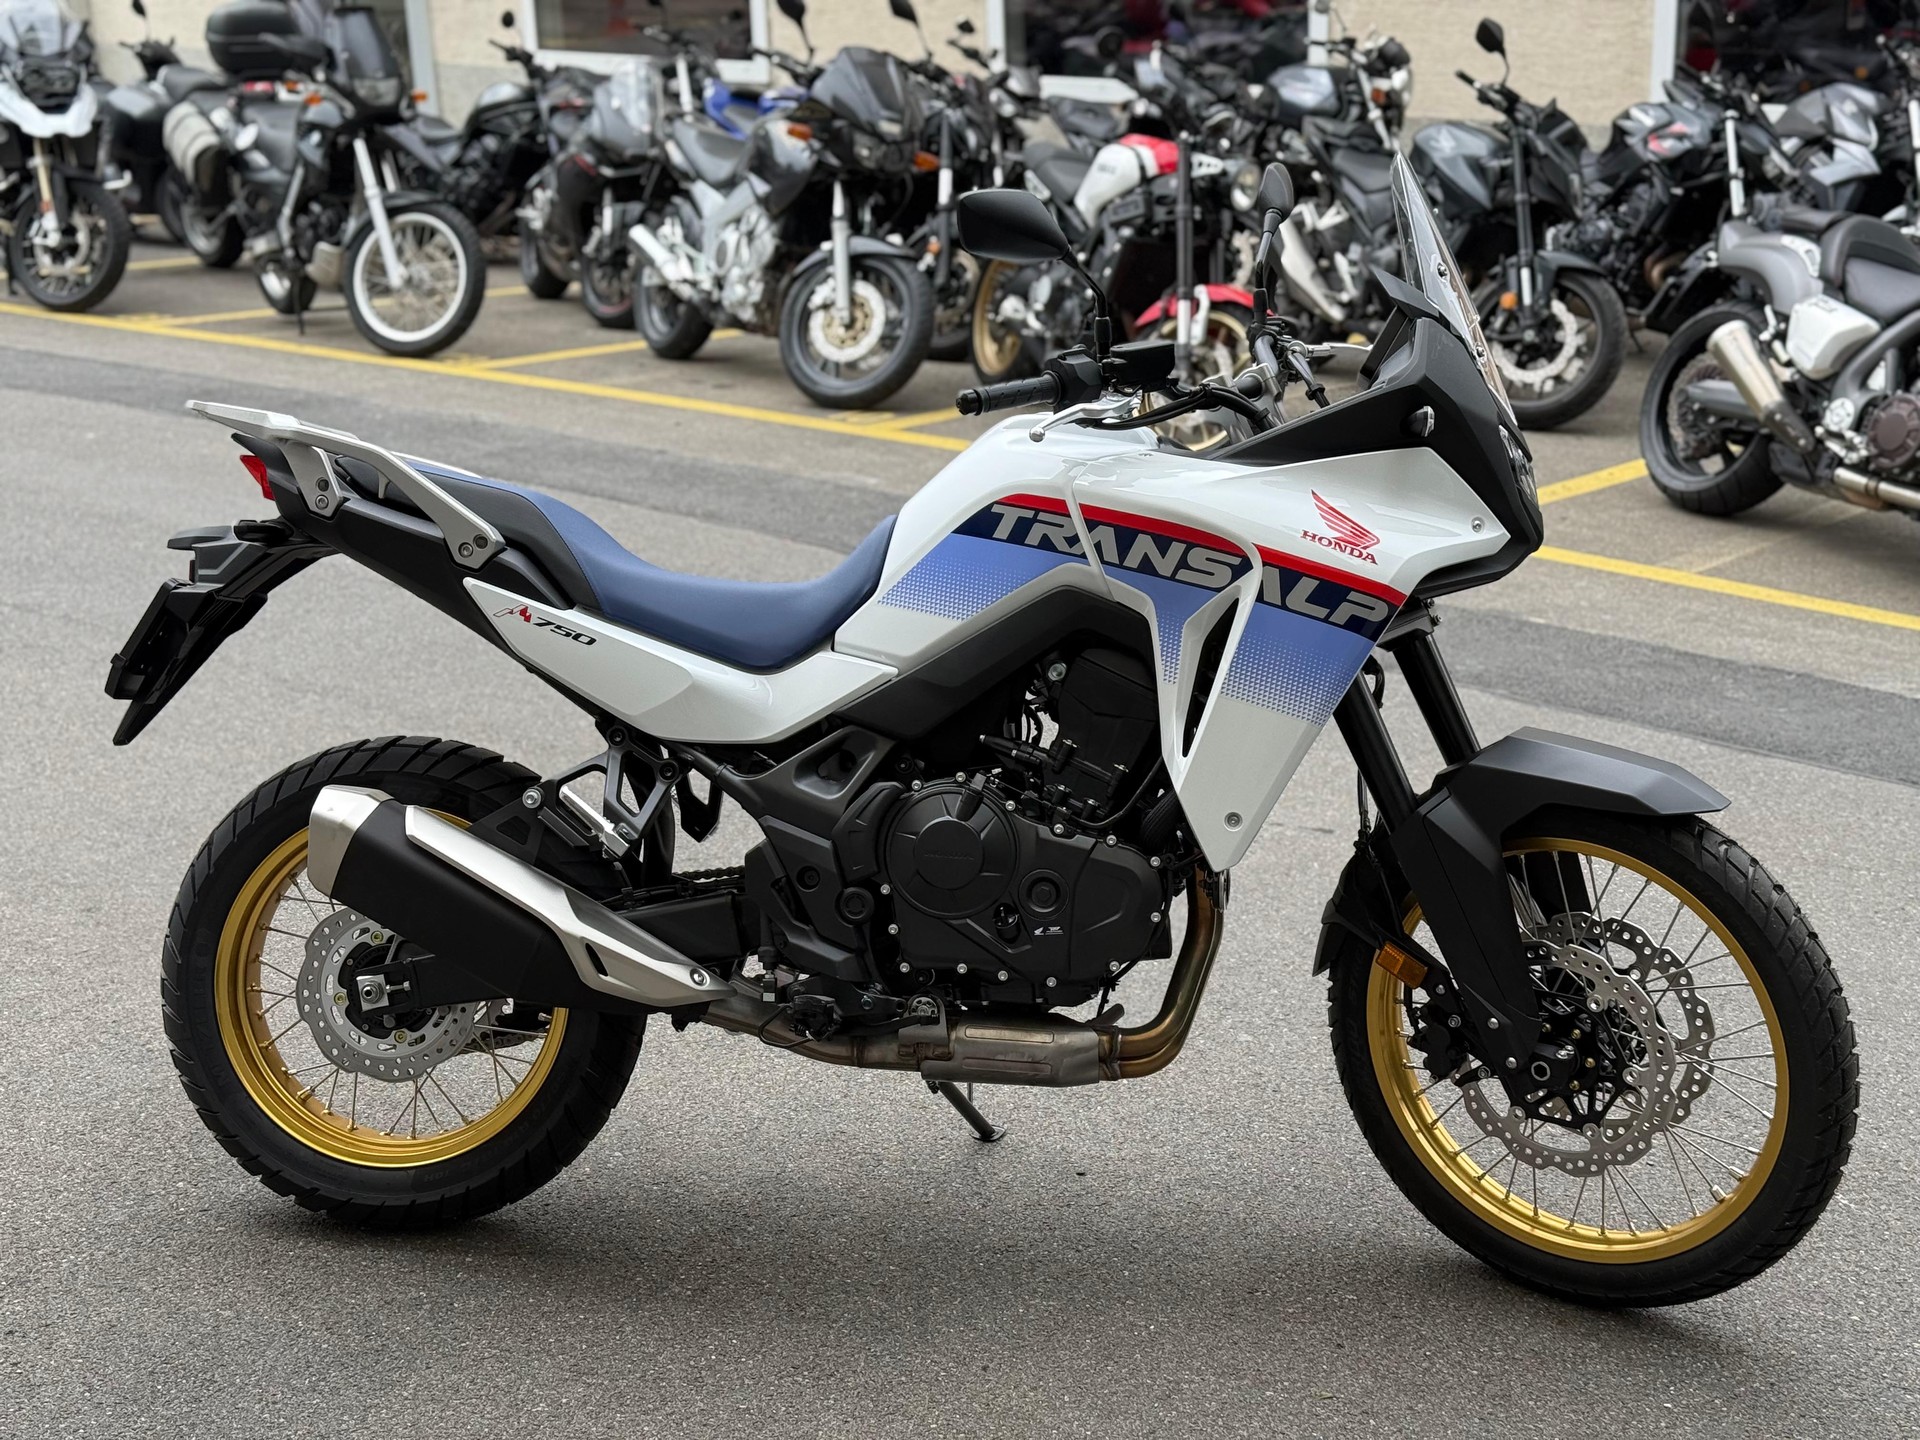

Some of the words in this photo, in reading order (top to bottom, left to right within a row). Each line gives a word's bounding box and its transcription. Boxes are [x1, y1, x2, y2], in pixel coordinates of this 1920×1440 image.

[991, 503, 1389, 626] TRANSALP
[1301, 529, 1378, 566] HONDA
[533, 616, 597, 646] 750
